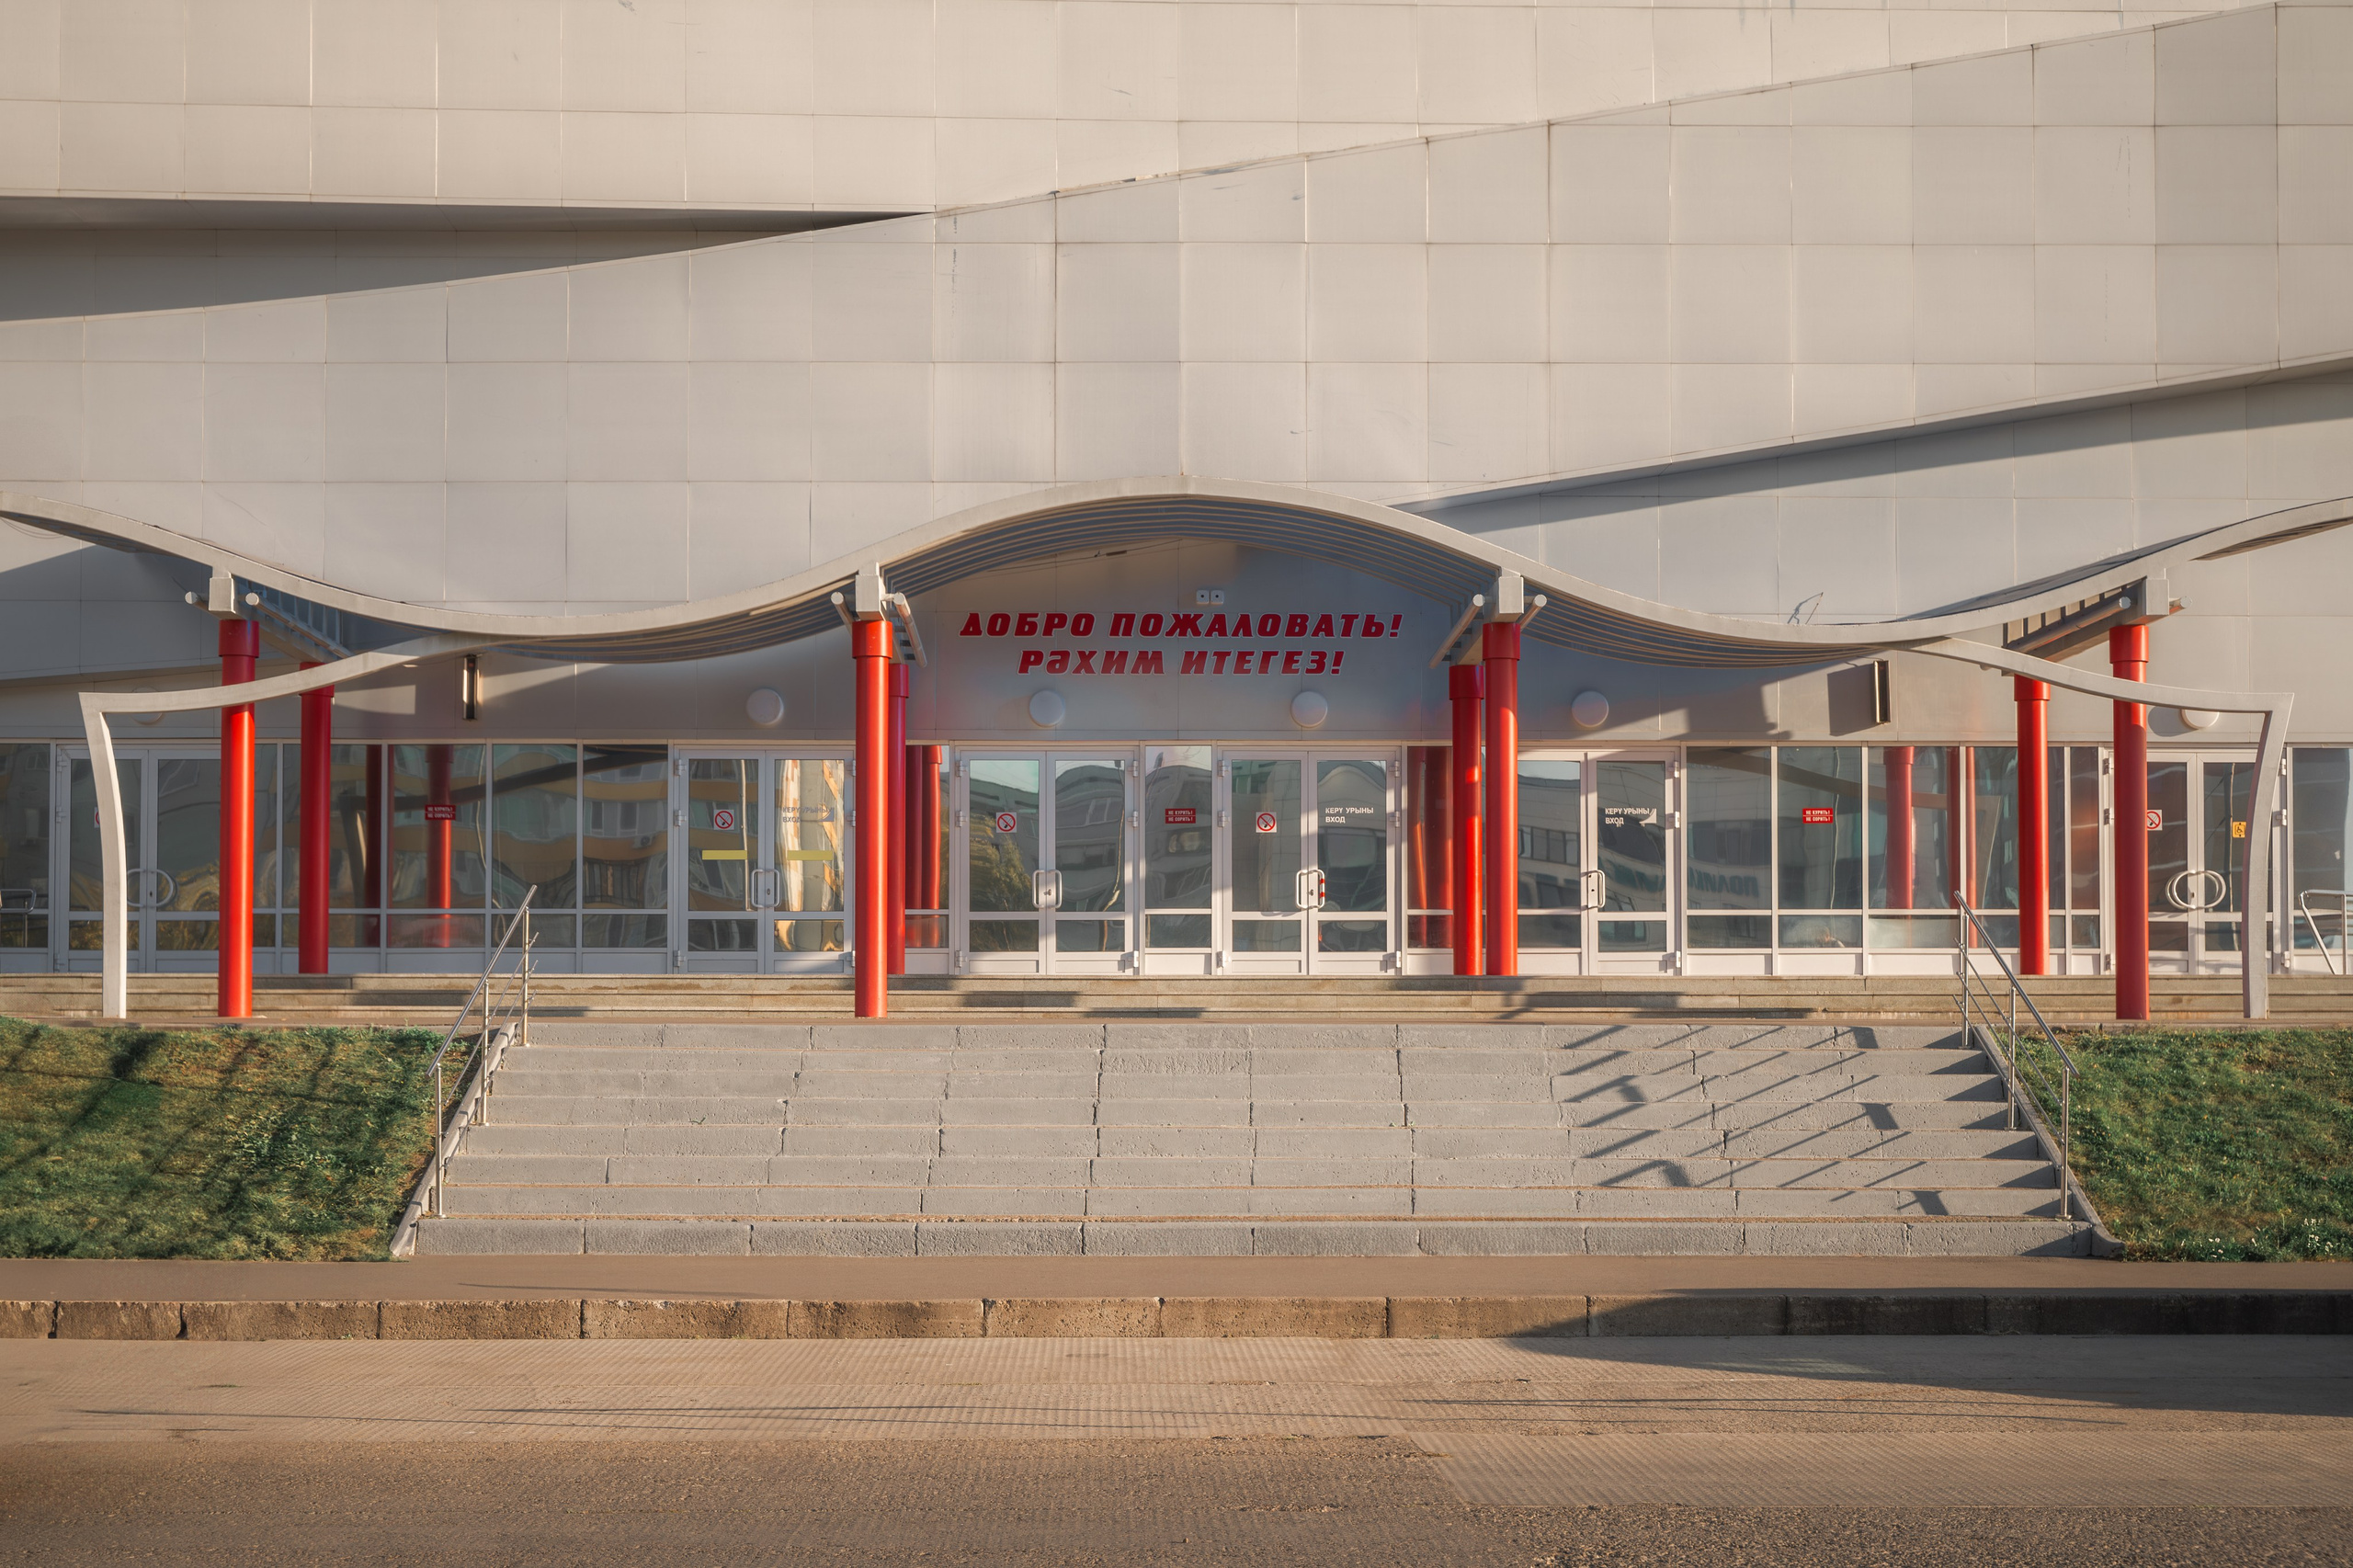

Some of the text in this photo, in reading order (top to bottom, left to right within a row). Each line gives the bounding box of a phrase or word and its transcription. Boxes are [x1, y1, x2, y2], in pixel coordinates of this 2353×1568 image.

[959, 611, 1404, 640] ДОБРО ПОЖАЛОВАТЬ!
[1179, 649, 1346, 676] ИТЕГЕЗ!
